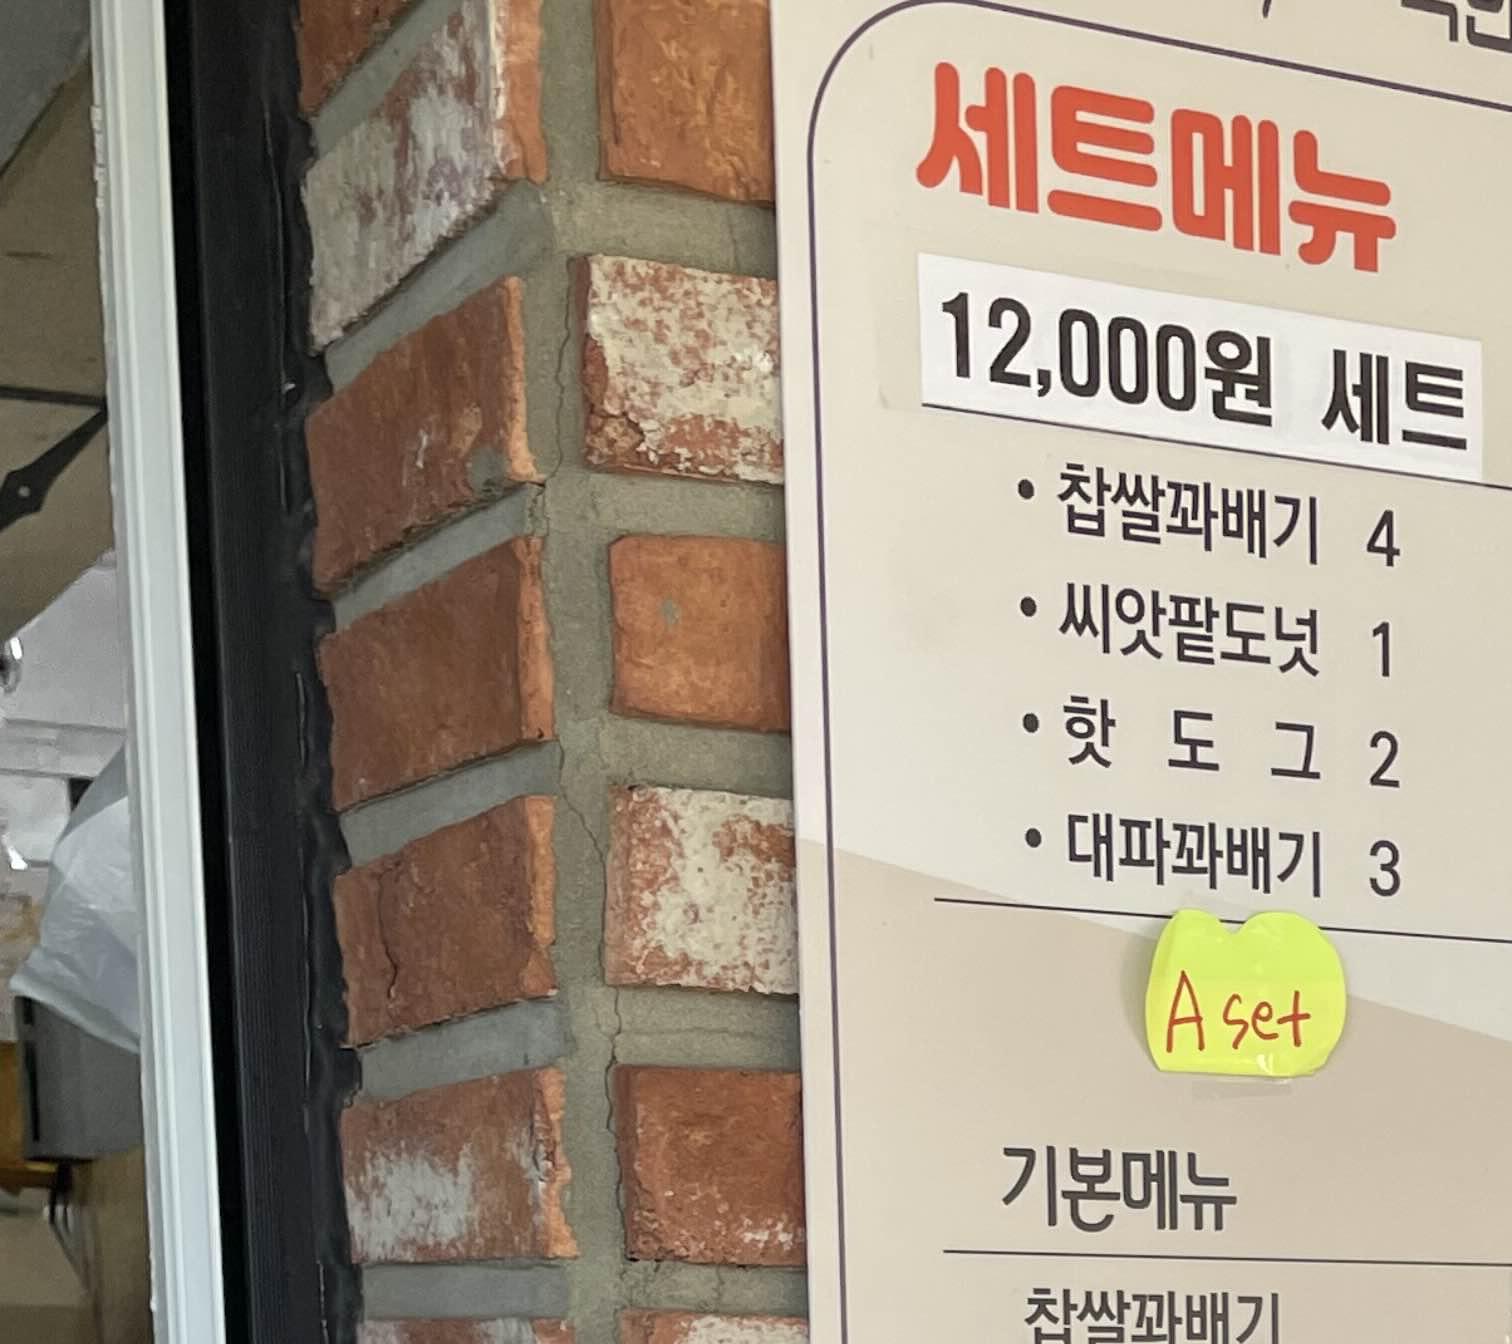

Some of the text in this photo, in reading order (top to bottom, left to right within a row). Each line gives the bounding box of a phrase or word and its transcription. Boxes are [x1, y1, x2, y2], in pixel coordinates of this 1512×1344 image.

[916, 61, 1397, 272] 세트메뉴
[942, 292, 1467, 450] 12,000원 세트
[1058, 463, 1400, 567] 찹쌀꽈배기 4
[1059, 583, 1389, 677] 씨앗팥도넛 1
[1064, 696, 1399, 788] 핫 도 그 2
[1068, 813, 1400, 897] 대파꽈배기 3
[1164, 970, 1312, 1055] A set
[1002, 1145, 1237, 1232] 기본메뉴
